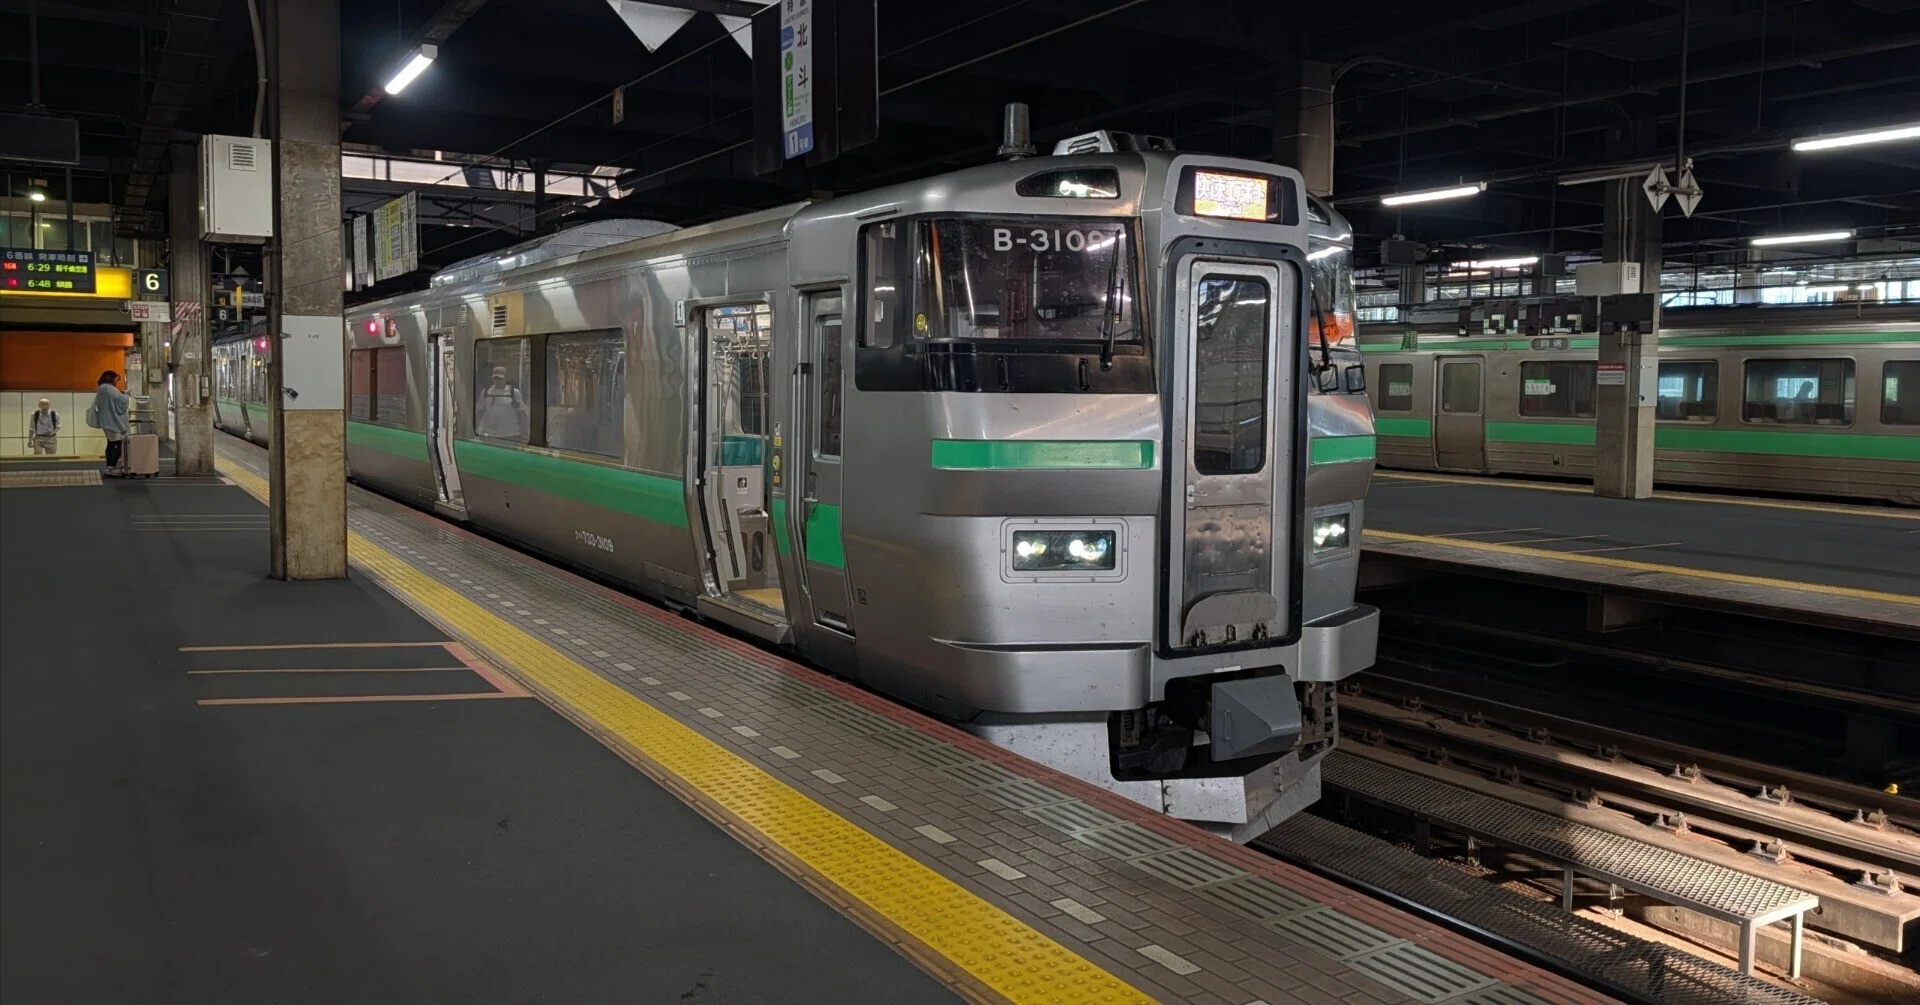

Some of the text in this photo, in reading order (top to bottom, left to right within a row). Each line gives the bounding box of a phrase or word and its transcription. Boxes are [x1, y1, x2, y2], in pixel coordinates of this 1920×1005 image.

[796, 7, 810, 19] EXPRESS
[789, 114, 807, 128] HOKUTO
[7, 251, 75, 262] 6番線 発車時刻
[27, 263, 50, 272] 6:29
[28, 279, 51, 288] 6:48
[145, 273, 160, 291] 6
[219, 309, 227, 320] 6
